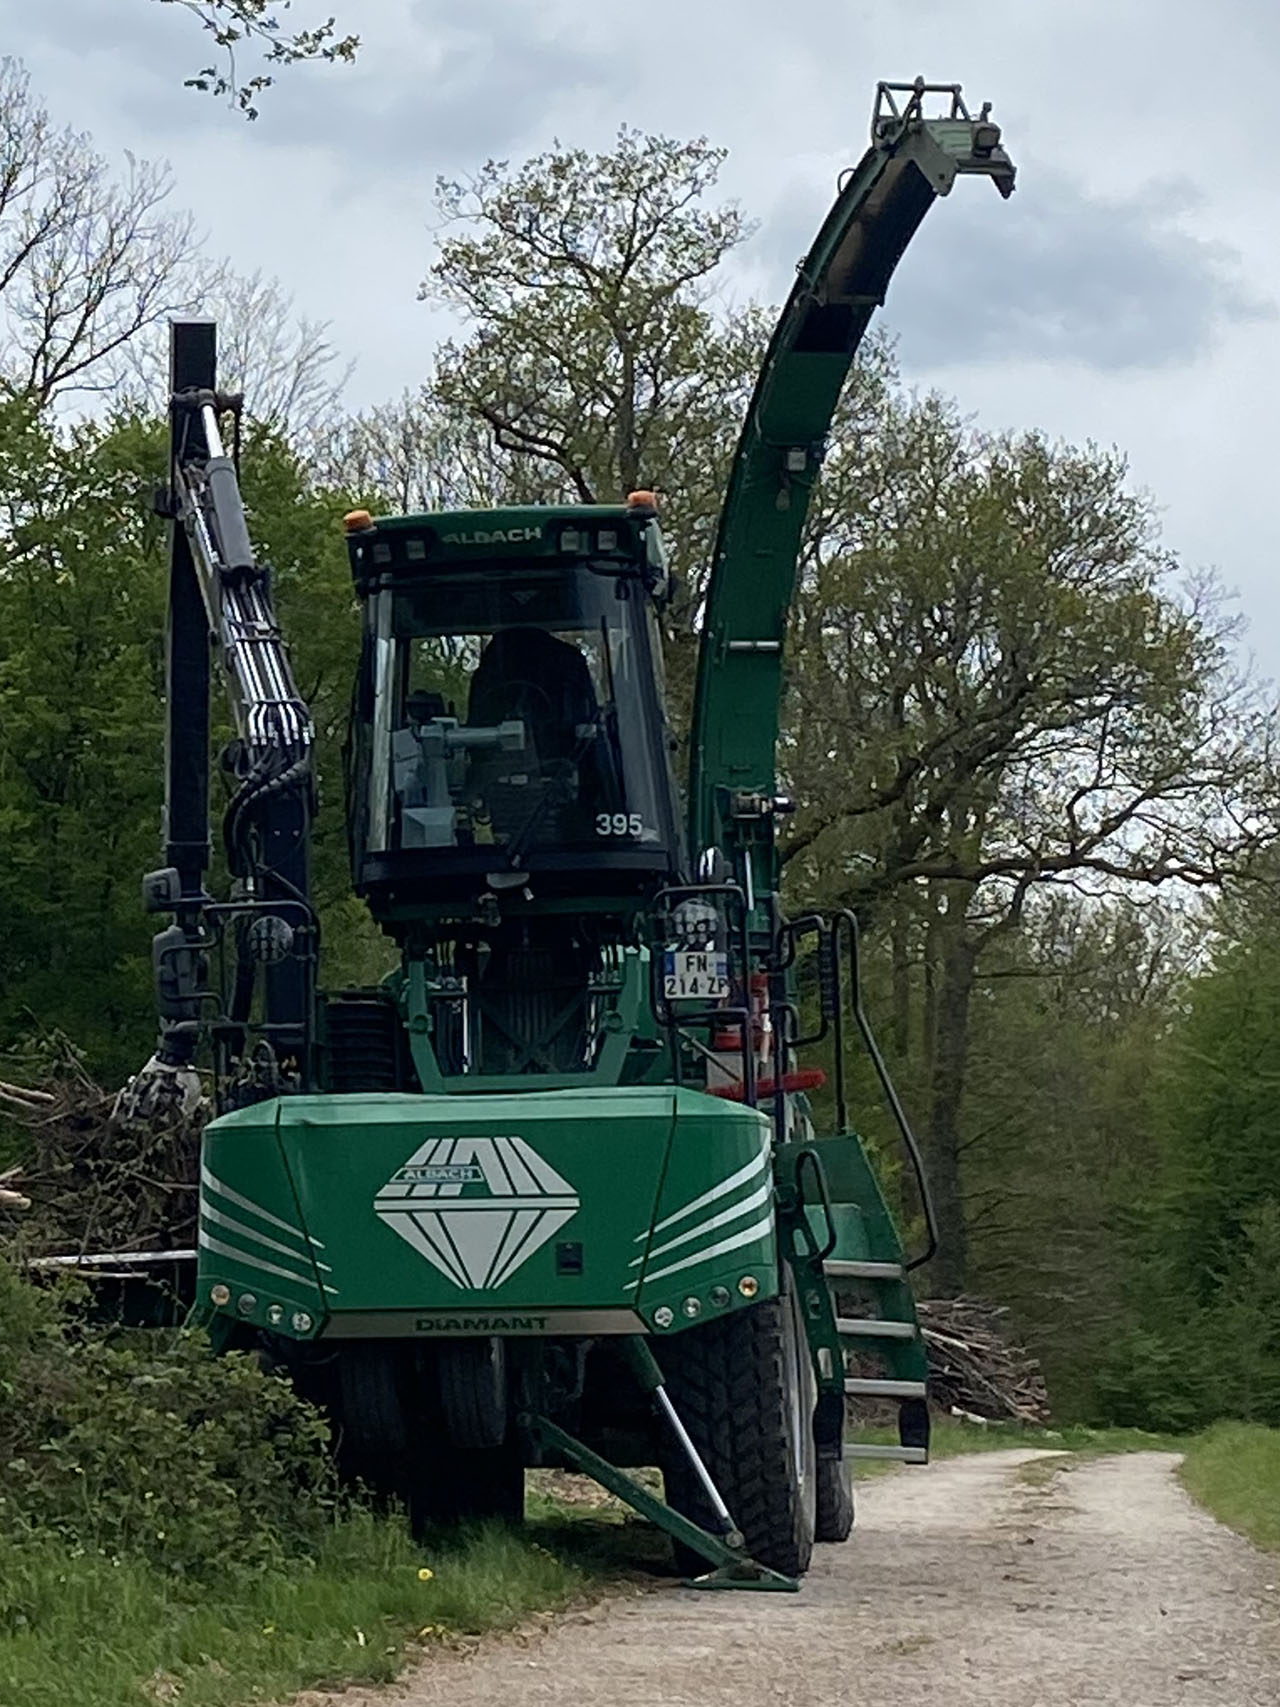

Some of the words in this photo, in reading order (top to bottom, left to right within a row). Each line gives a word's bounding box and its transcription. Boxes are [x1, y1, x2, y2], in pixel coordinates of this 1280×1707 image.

[596, 813, 642, 835] 395
[404, 1168, 473, 1180] ALBACH
[416, 1317, 549, 1331] DIAMANT
